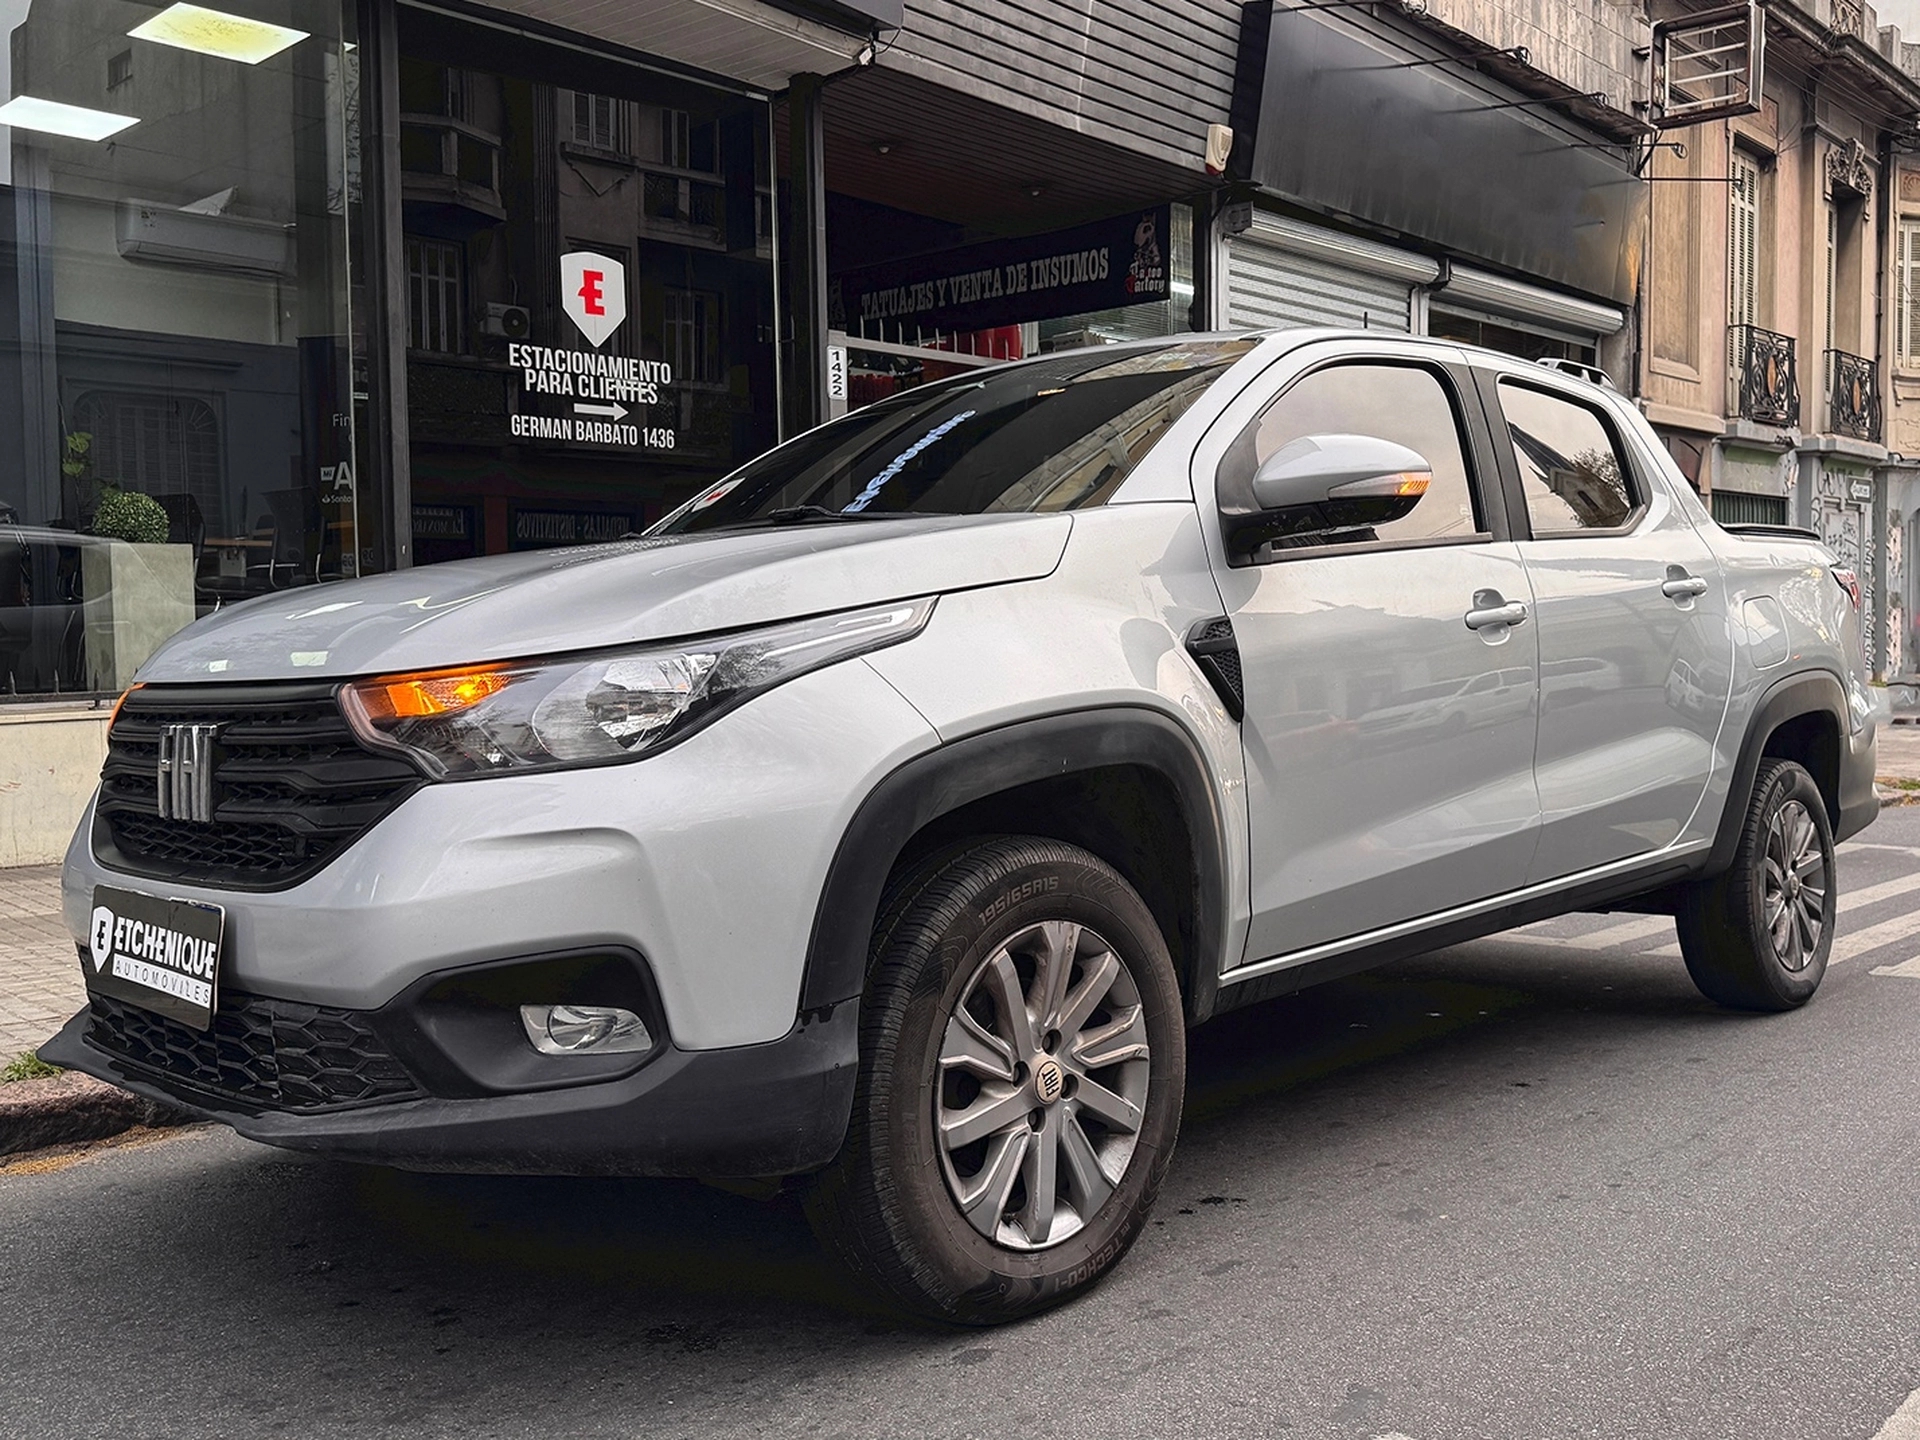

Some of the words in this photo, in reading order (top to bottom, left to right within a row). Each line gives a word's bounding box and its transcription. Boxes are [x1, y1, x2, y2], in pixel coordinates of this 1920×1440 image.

[861, 280, 934, 320] TATUAJES
[936, 278, 948, 307] Y
[949, 267, 1002, 304] VENTA
[1006, 262, 1027, 295] DE
[1030, 247, 1109, 290] INSUMOS
[508, 342, 672, 385] ESTACIONAMIENTO
[831, 350, 843, 396] 1422
[525, 368, 574, 397] PARA
[577, 374, 659, 404] CLIENTES
[511, 414, 573, 441] GERMAN
[575, 420, 639, 447] BARBATO
[642, 426, 676, 449] 1436
[158, 724, 217, 822] FIAT
[114, 916, 217, 980] ETCHENIQUE
[1041, 1067, 1060, 1098] FIAT
